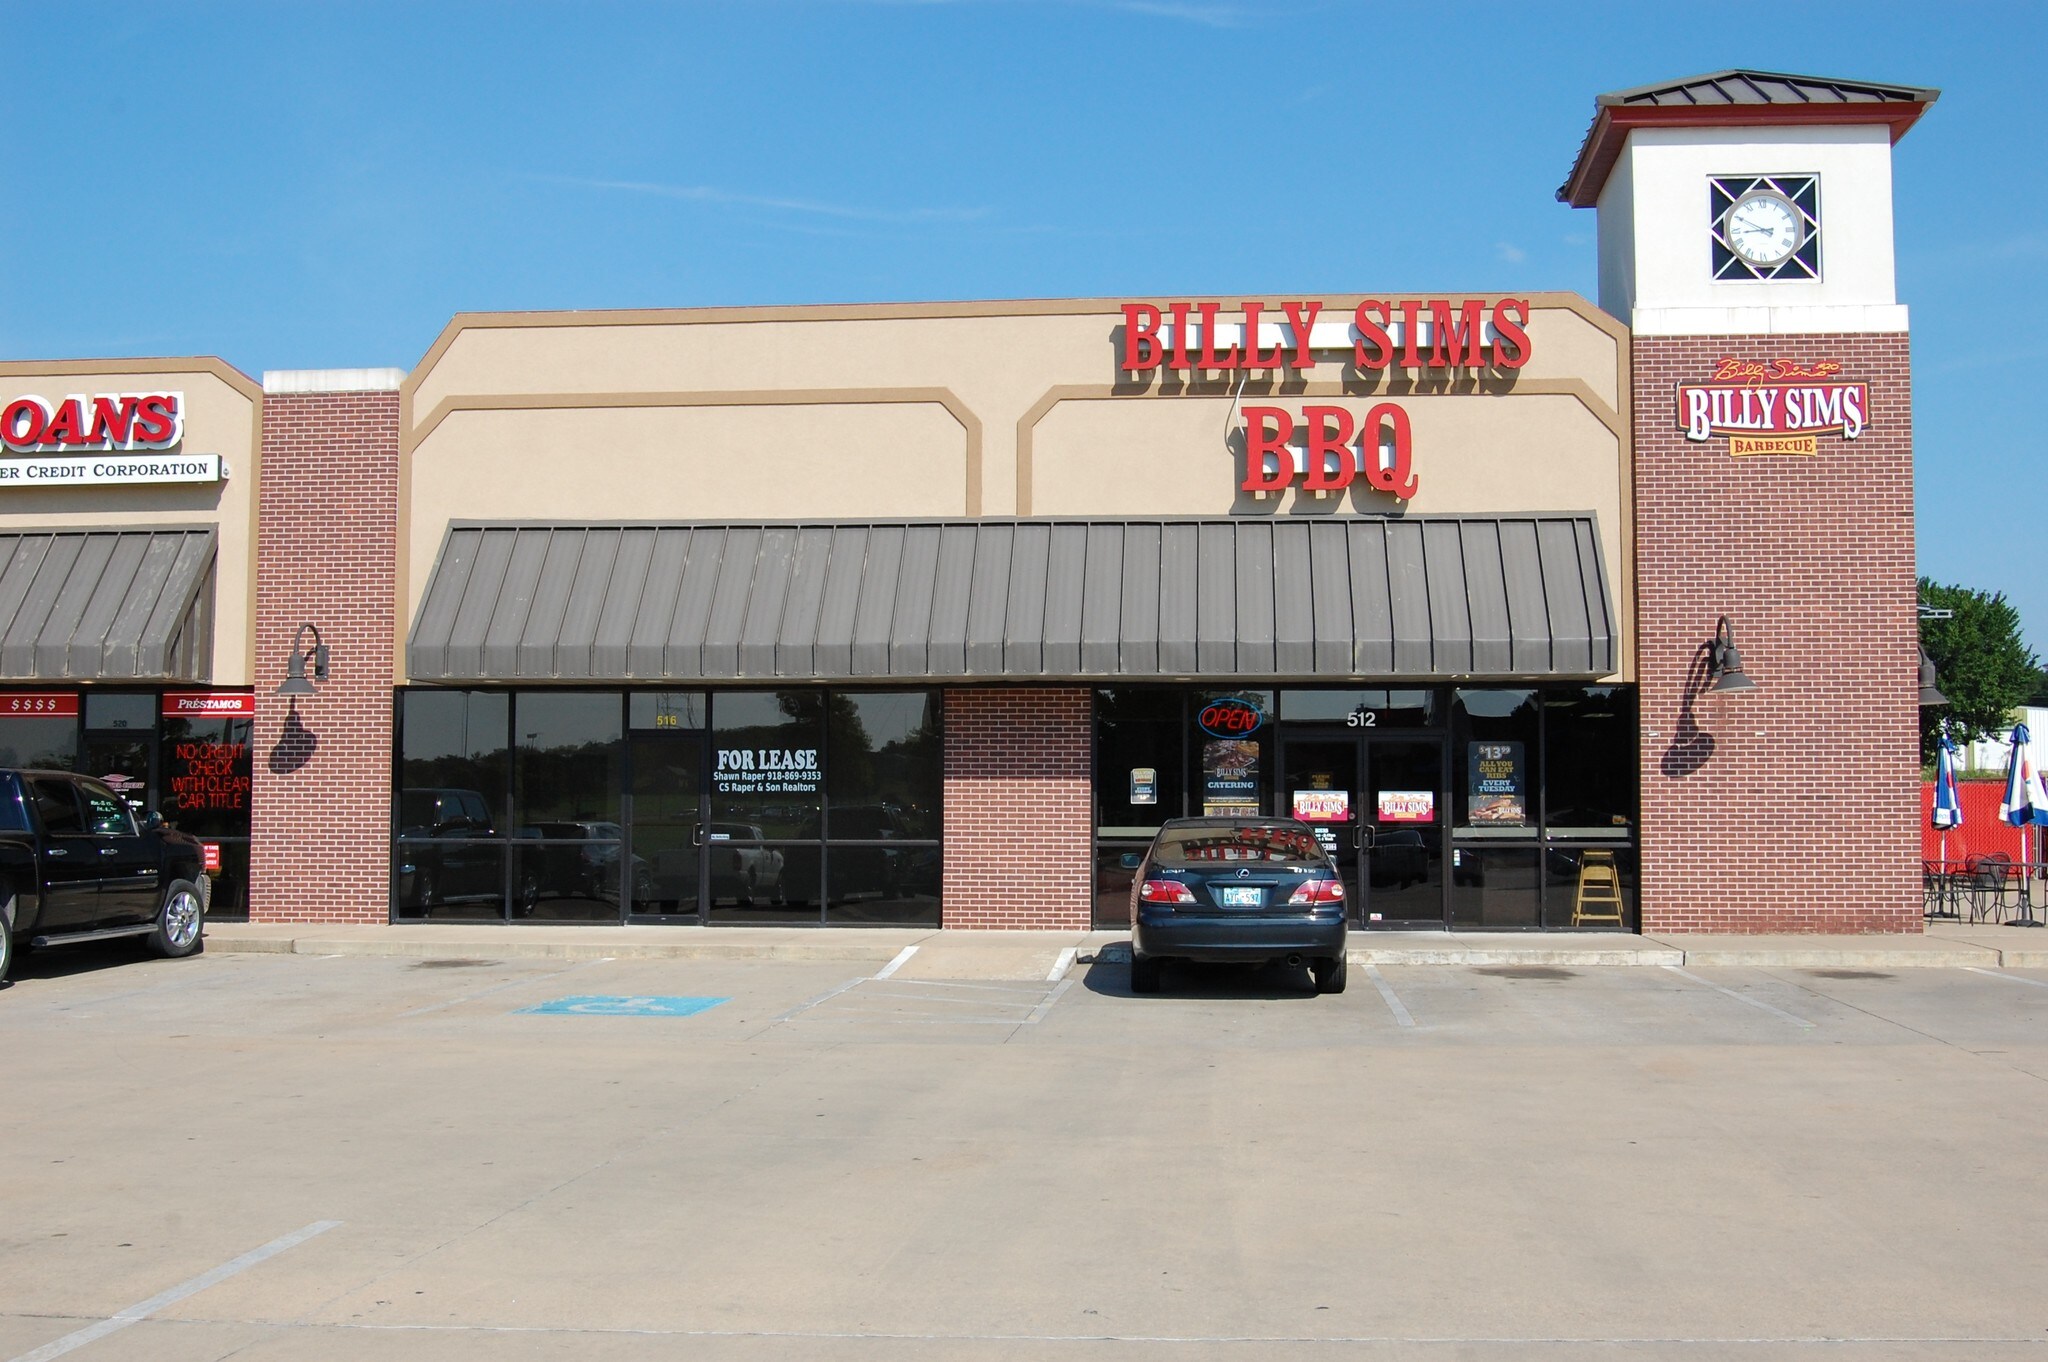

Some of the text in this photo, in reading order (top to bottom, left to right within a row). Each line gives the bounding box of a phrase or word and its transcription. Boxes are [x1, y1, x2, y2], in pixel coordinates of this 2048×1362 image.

[1121, 298, 1531, 370] BILLY SIMS
[1714, 359, 1764, 395] Billy
[1769, 359, 1827, 380] Sims
[0, 395, 178, 446] OANS
[1686, 386, 1862, 440] BILLY SIMS
[1241, 402, 1418, 499] BBQ
[1734, 439, 1813, 453] BARBECUE
[0, 462, 208, 478] ER CREDIT CORPORATION
[113, 720, 127, 728] 520
[657, 715, 677, 726] 516
[1201, 708, 1257, 729] OPEN
[1347, 712, 1376, 727] 512
[176, 744, 244, 759] NO CREDIT
[717, 749, 818, 770] FOR LEASE
[189, 760, 232, 775] CHECK
[207, 776, 250, 792] CLEAR
[713, 771, 822, 782] Shawn Raper 918-869-9353
[719, 782, 816, 794] CS Raper & Son Realtors
[1207, 781, 1254, 789] CATERING
[178, 793, 242, 809] CAR TITLE
